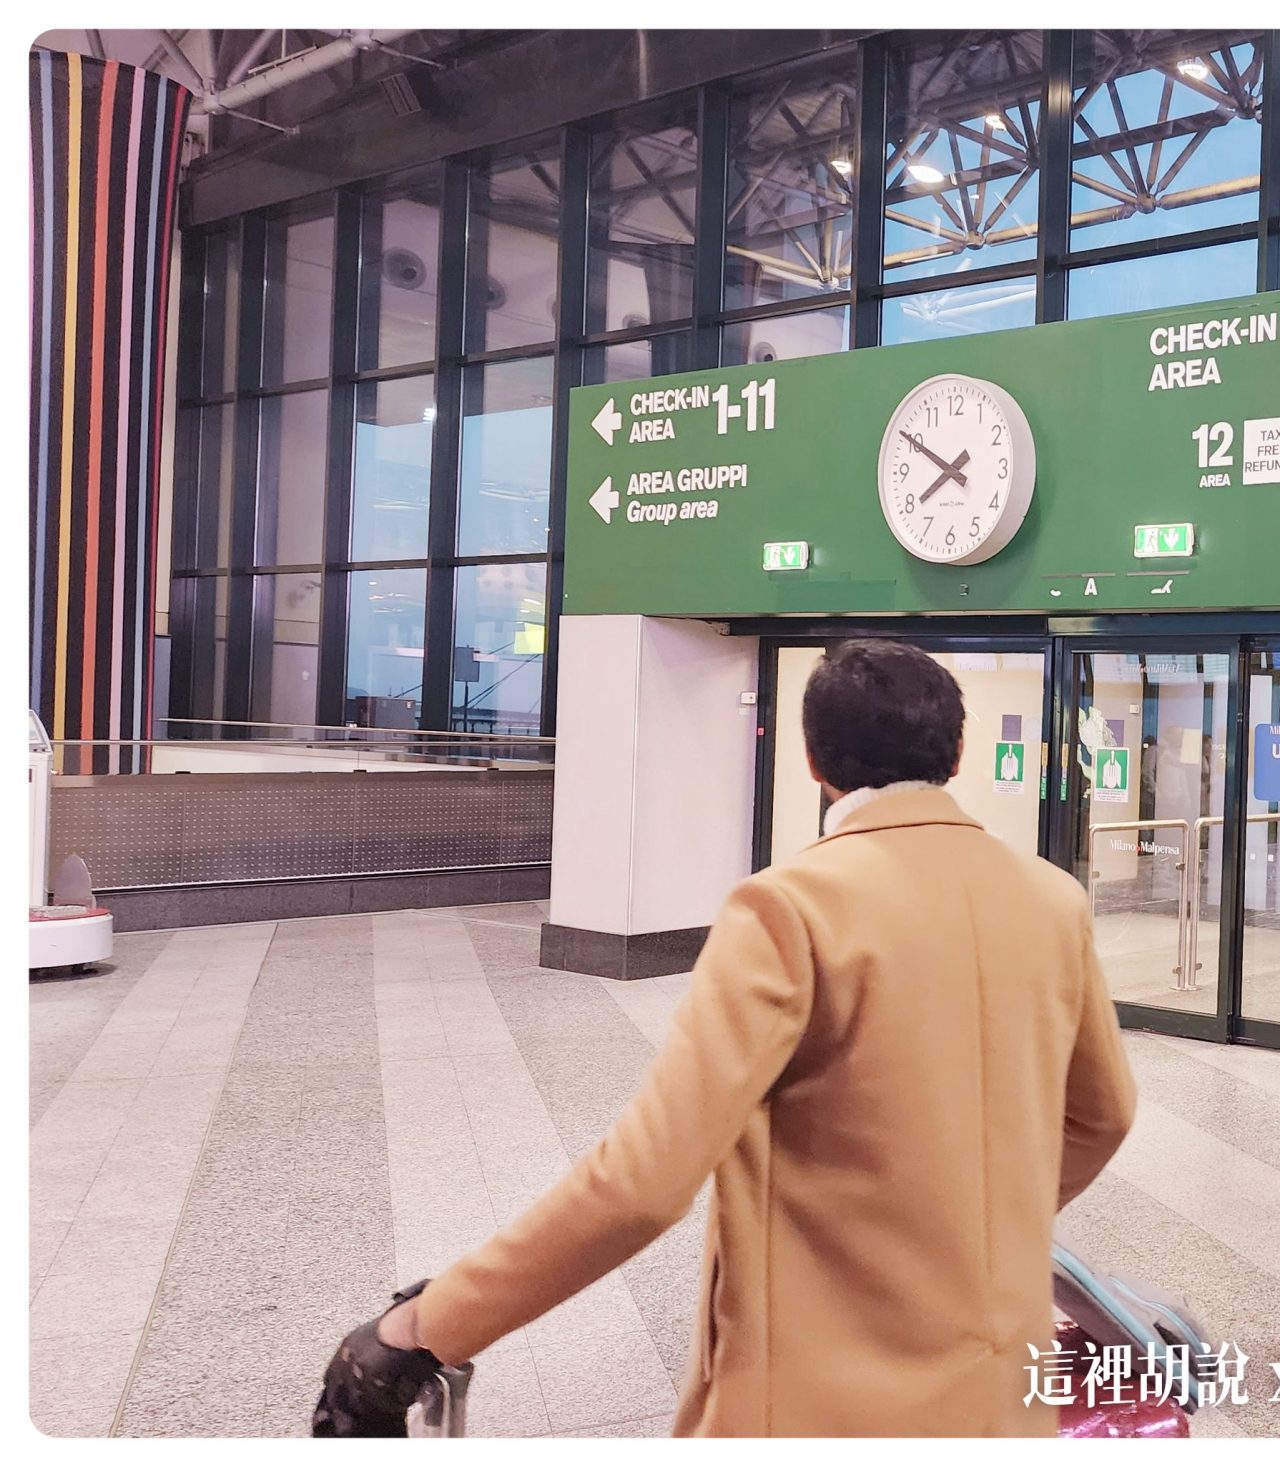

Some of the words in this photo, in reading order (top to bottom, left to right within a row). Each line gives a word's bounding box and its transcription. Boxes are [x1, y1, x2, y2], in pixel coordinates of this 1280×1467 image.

[1149, 312, 1277, 356] CHECK-IN
[1148, 357, 1222, 392] AREA
[630, 385, 709, 416] CHECK-IN
[712, 378, 776, 435] 1-11
[947, 394, 964, 416] 12
[976, 403, 983, 424] 1
[925, 407, 939, 428] 11
[629, 418, 676, 444] AREA
[991, 424, 1002, 446] 2
[1191, 421, 1234, 468] 12
[899, 463, 910, 483] 9
[997, 457, 1008, 479] 3
[627, 470, 675, 496] AREA
[677, 463, 748, 492] GRUPPI
[1199, 473, 1231, 488] AREA
[905, 493, 915, 514] 8
[988, 490, 1000, 511] 4
[626, 500, 678, 526] Group
[679, 500, 719, 520] area
[923, 516, 935, 537] 7
[945, 525, 956, 546] 6
[969, 516, 981, 537] 5
[1084, 577, 1098, 596] A
[1109, 839, 1136, 852] Milano
[1140, 841, 1180, 856] Malpensa
